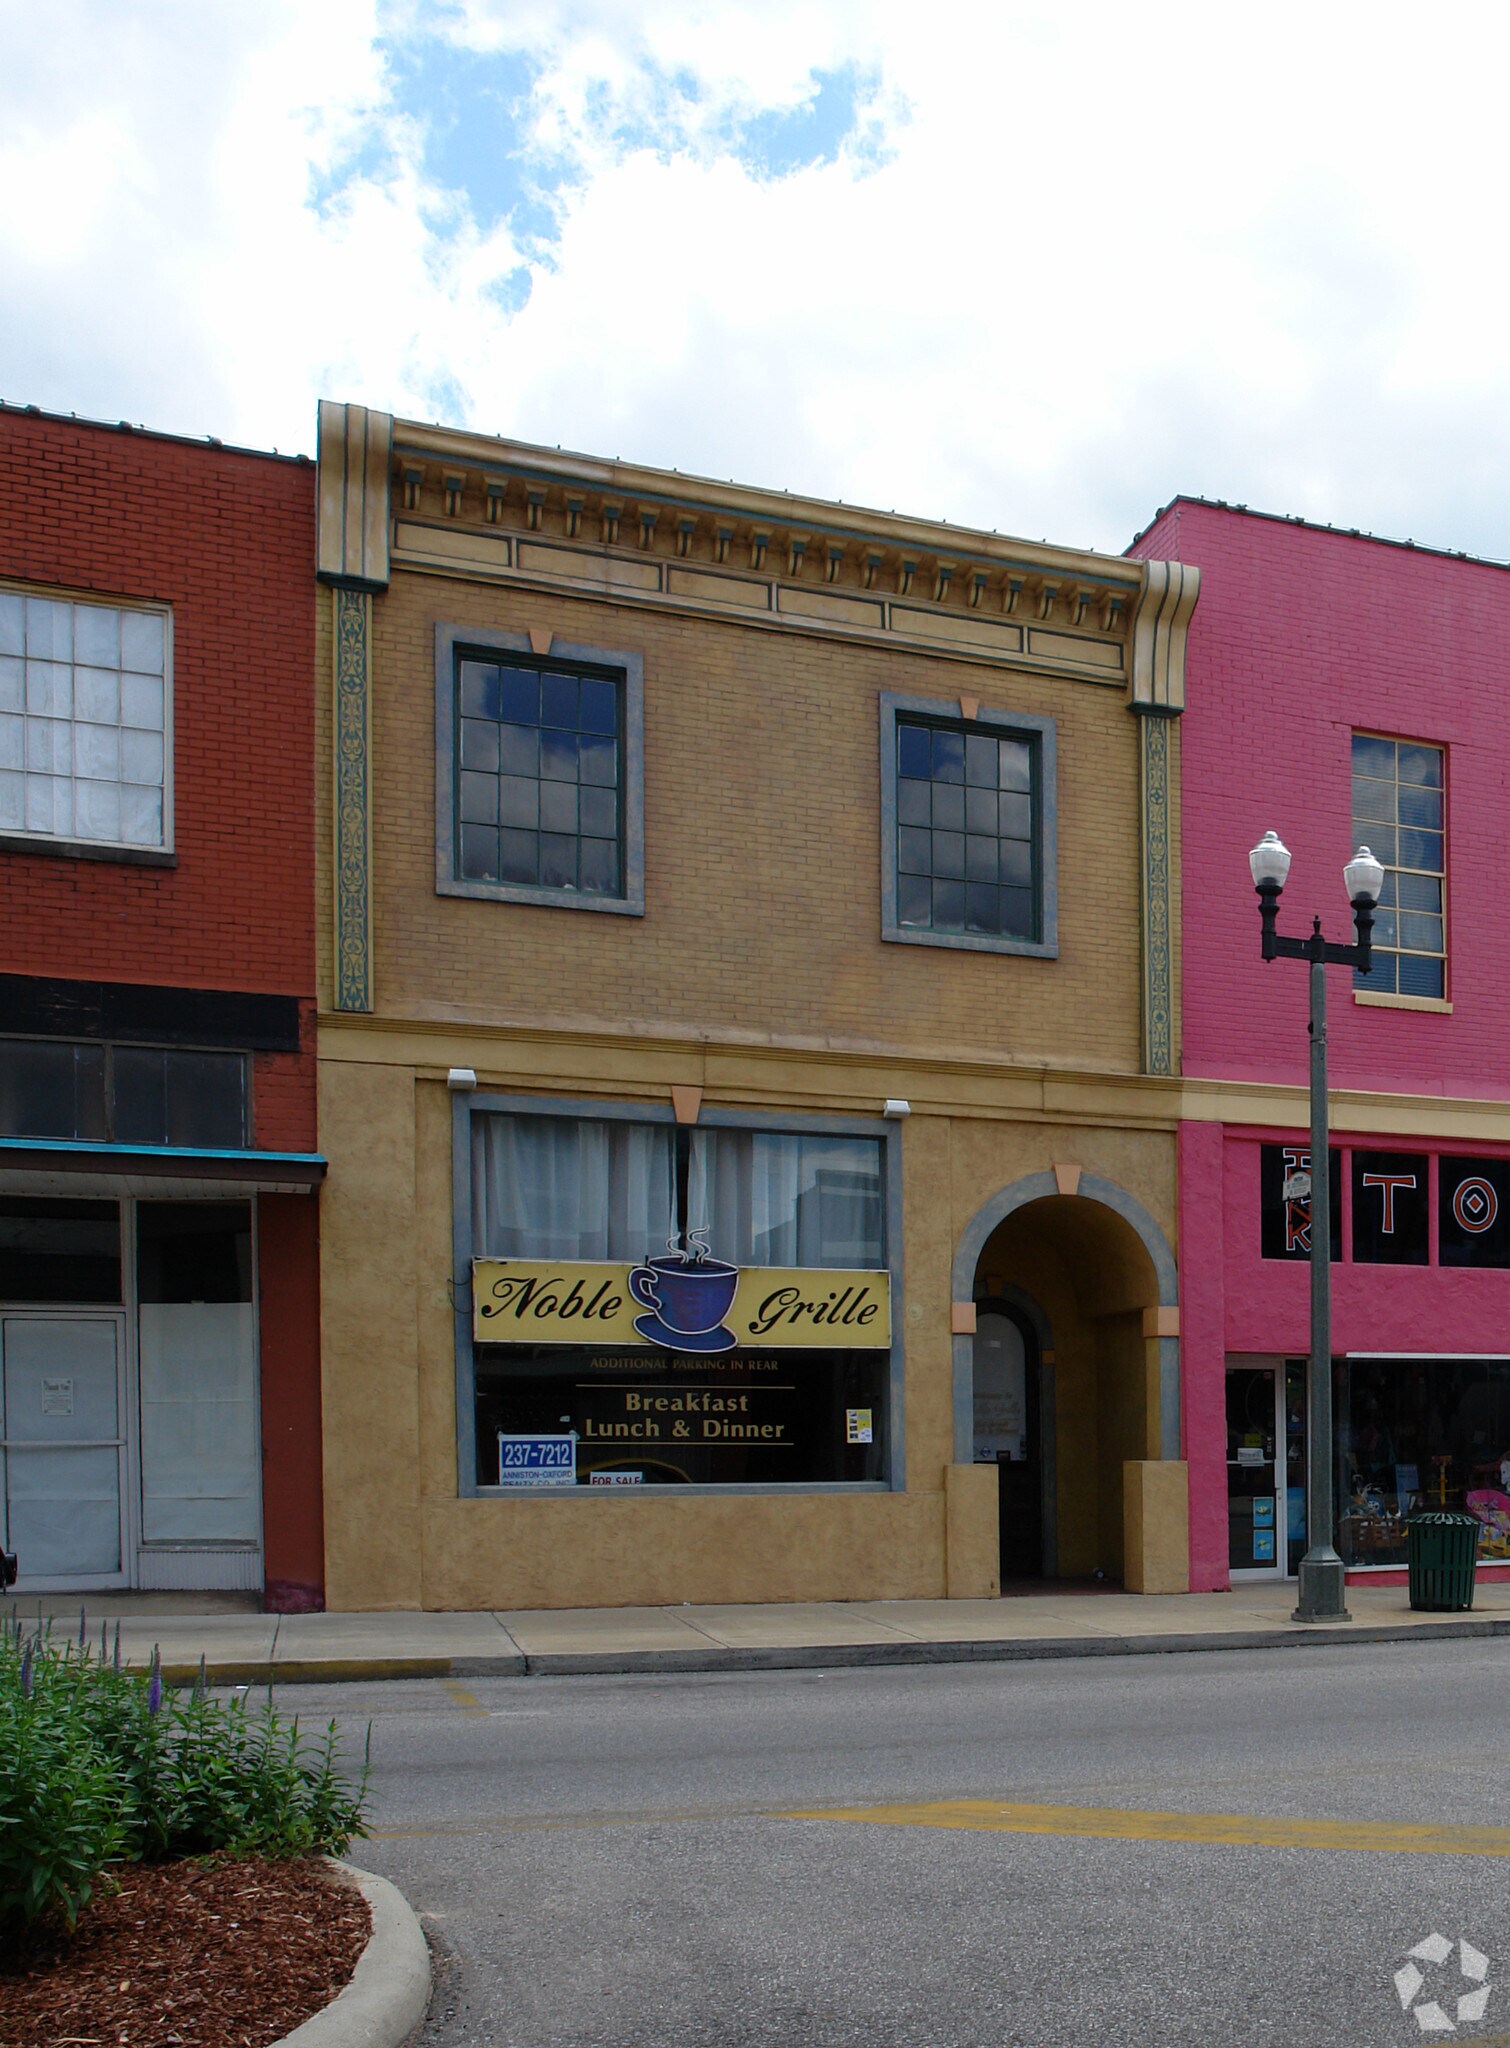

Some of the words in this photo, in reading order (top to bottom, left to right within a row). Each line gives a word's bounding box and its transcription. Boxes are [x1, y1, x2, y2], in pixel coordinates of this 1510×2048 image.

[481, 1277, 622, 1319] Noble
[749, 1287, 878, 1334] Grille
[591, 1358, 667, 1369] ADDITIONAL
[672, 1359, 725, 1370] PARKING
[730, 1360, 744, 1370] IN
[749, 1360, 779, 1371] REAR
[626, 1392, 749, 1411] Breakfast
[585, 1418, 660, 1437] Lunch
[671, 1419, 690, 1438] &
[703, 1419, 785, 1438] Dinner
[504, 1444, 570, 1466] 237-7212
[502, 1470, 572, 1479] ANNISTON-OXFORD
[592, 1476, 612, 1485] FOR
[615, 1476, 641, 1485] SALE
